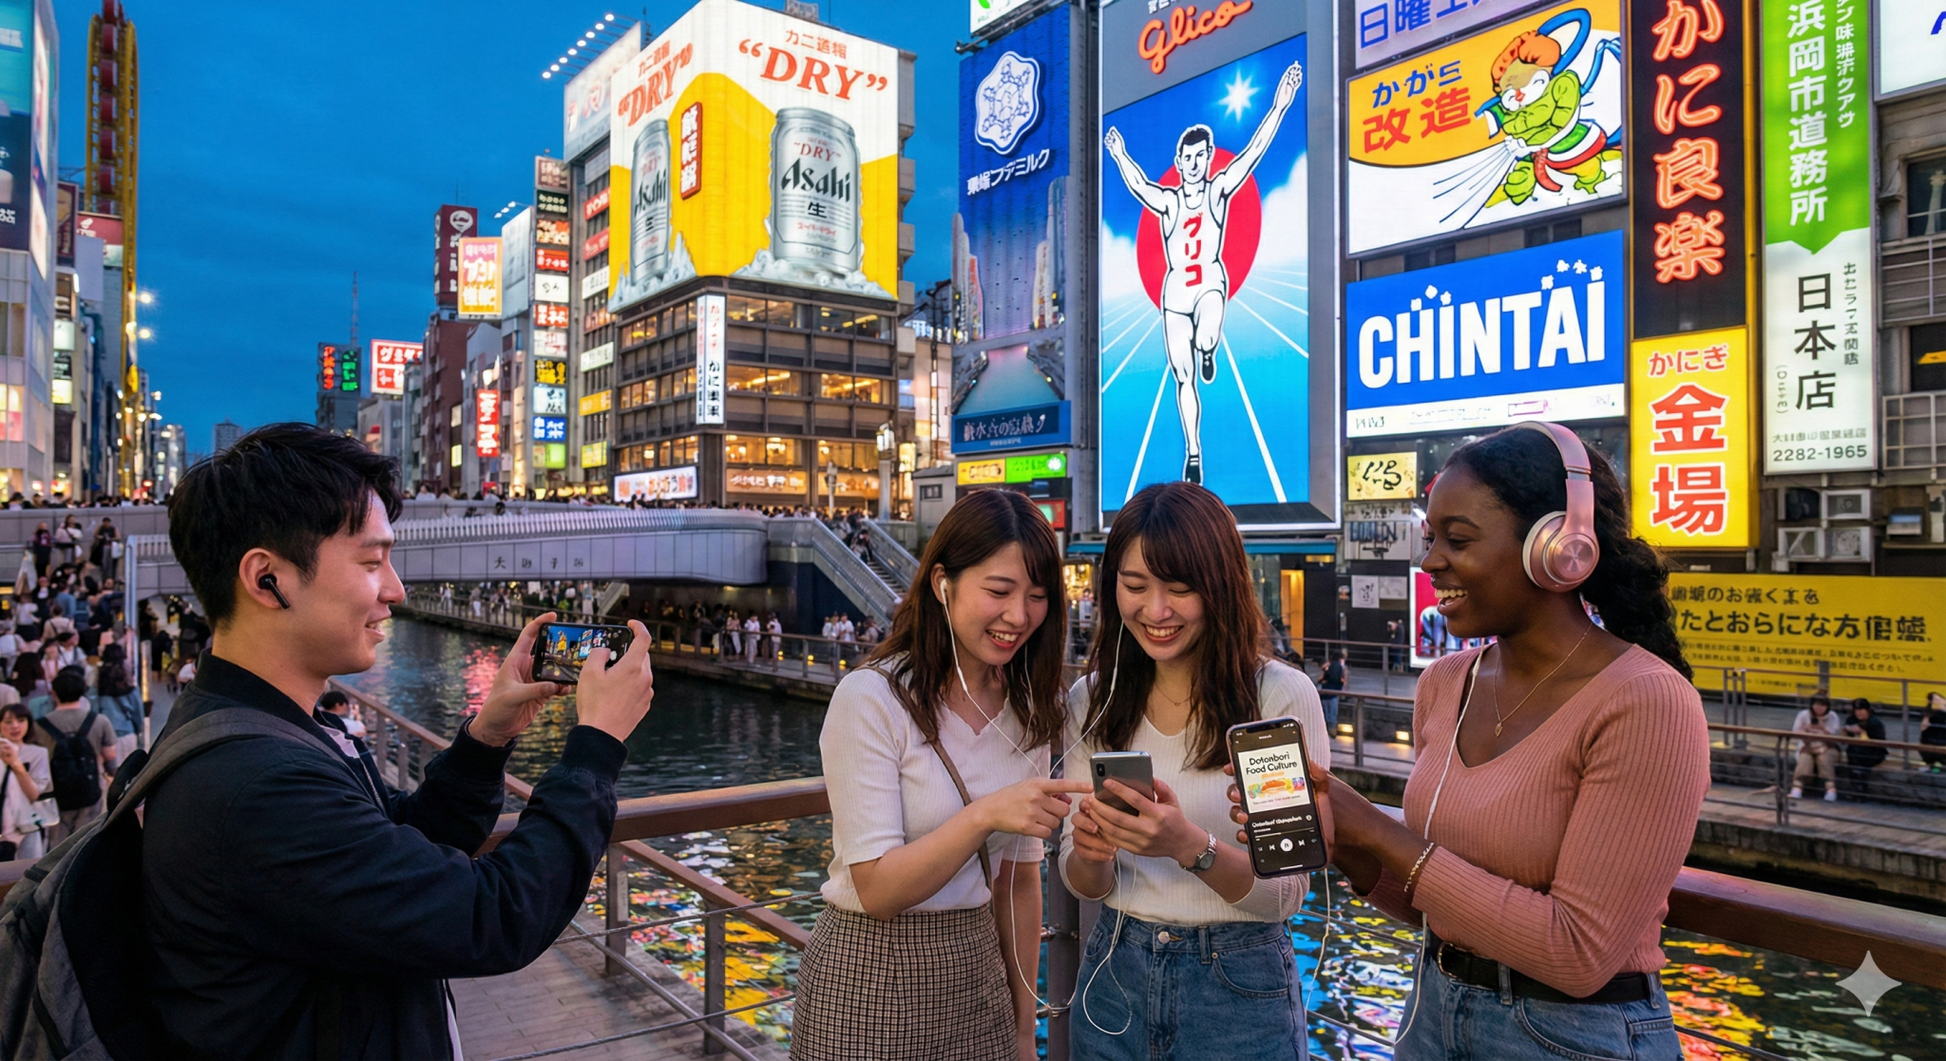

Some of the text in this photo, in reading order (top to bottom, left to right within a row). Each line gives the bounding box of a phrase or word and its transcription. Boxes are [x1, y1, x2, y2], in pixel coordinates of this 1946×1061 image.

[1137, 0, 1252, 75] Glico
[1362, 87, 1472, 154] 改造
[1652, 0, 1725, 284] かに良楽
[780, 157, 851, 203] Asahi
[807, 201, 828, 219] 生
[1183, 211, 1204, 288] グリコ
[1358, 280, 1605, 389] CHINTAI
[1794, 273, 1837, 411] 日本店
[1651, 384, 1727, 535] 金場
[1773, 444, 1867, 462] 2282-1965
[1246, 761, 1297, 774] Food Culture
